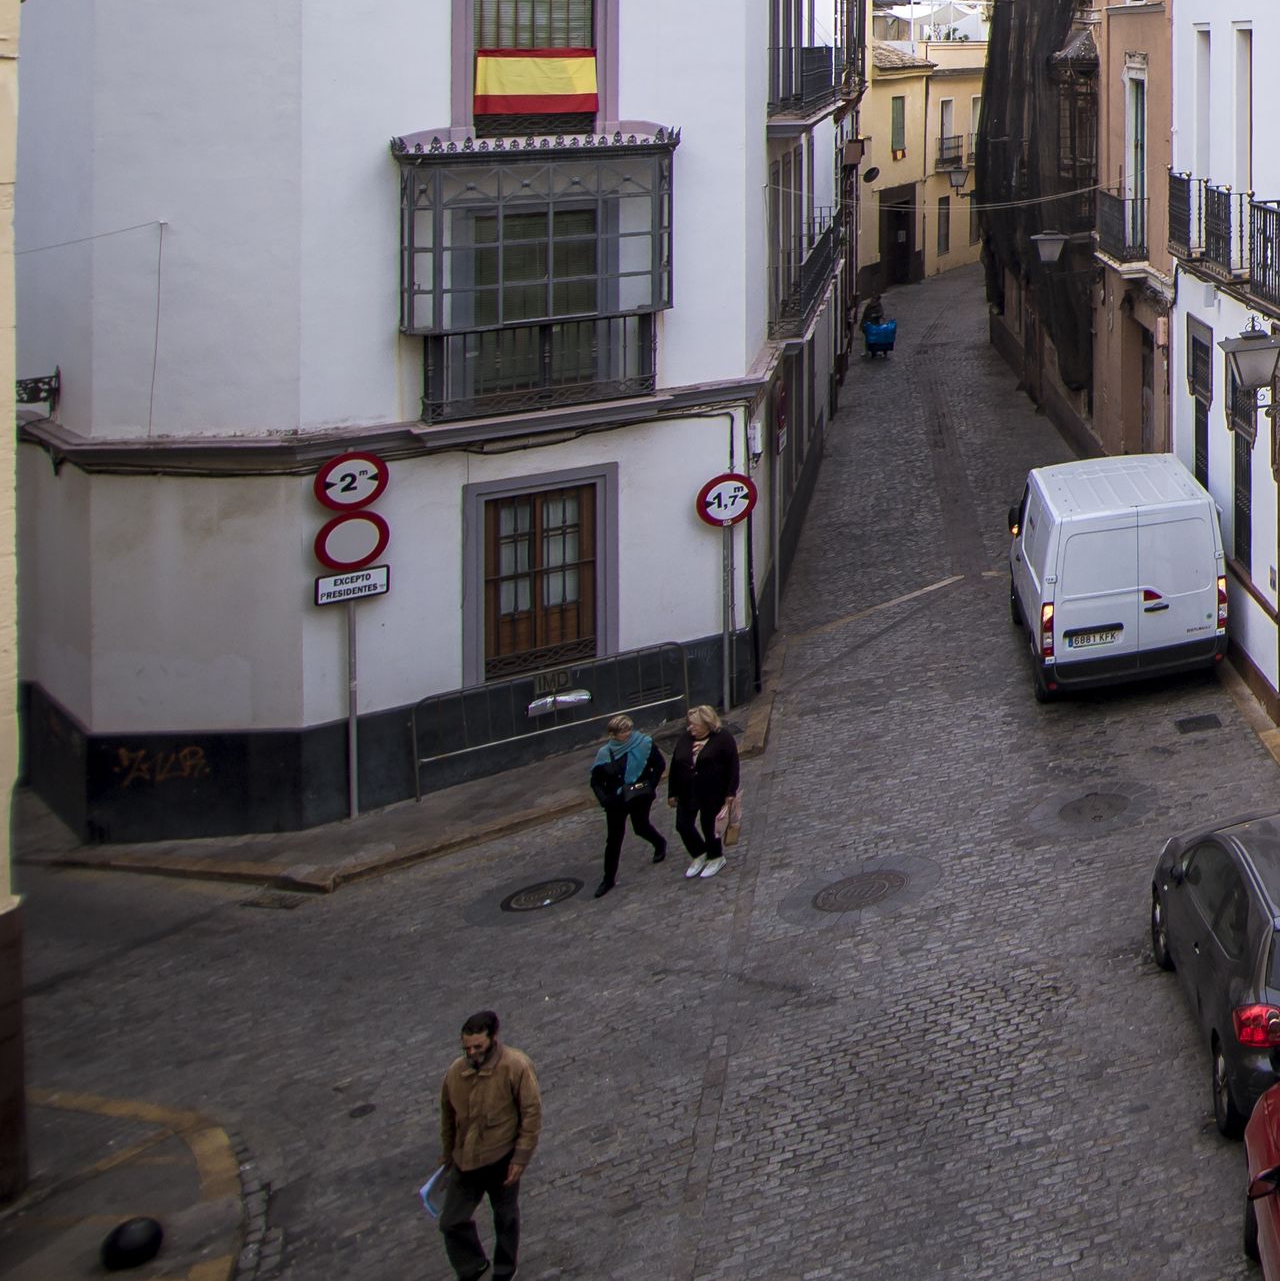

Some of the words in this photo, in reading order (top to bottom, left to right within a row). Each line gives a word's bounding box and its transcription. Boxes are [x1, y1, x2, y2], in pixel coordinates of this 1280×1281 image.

[333, 572, 371, 587] EXCEPTO
[1099, 631, 1116, 642] KFK
[537, 671, 569, 692] IMD
